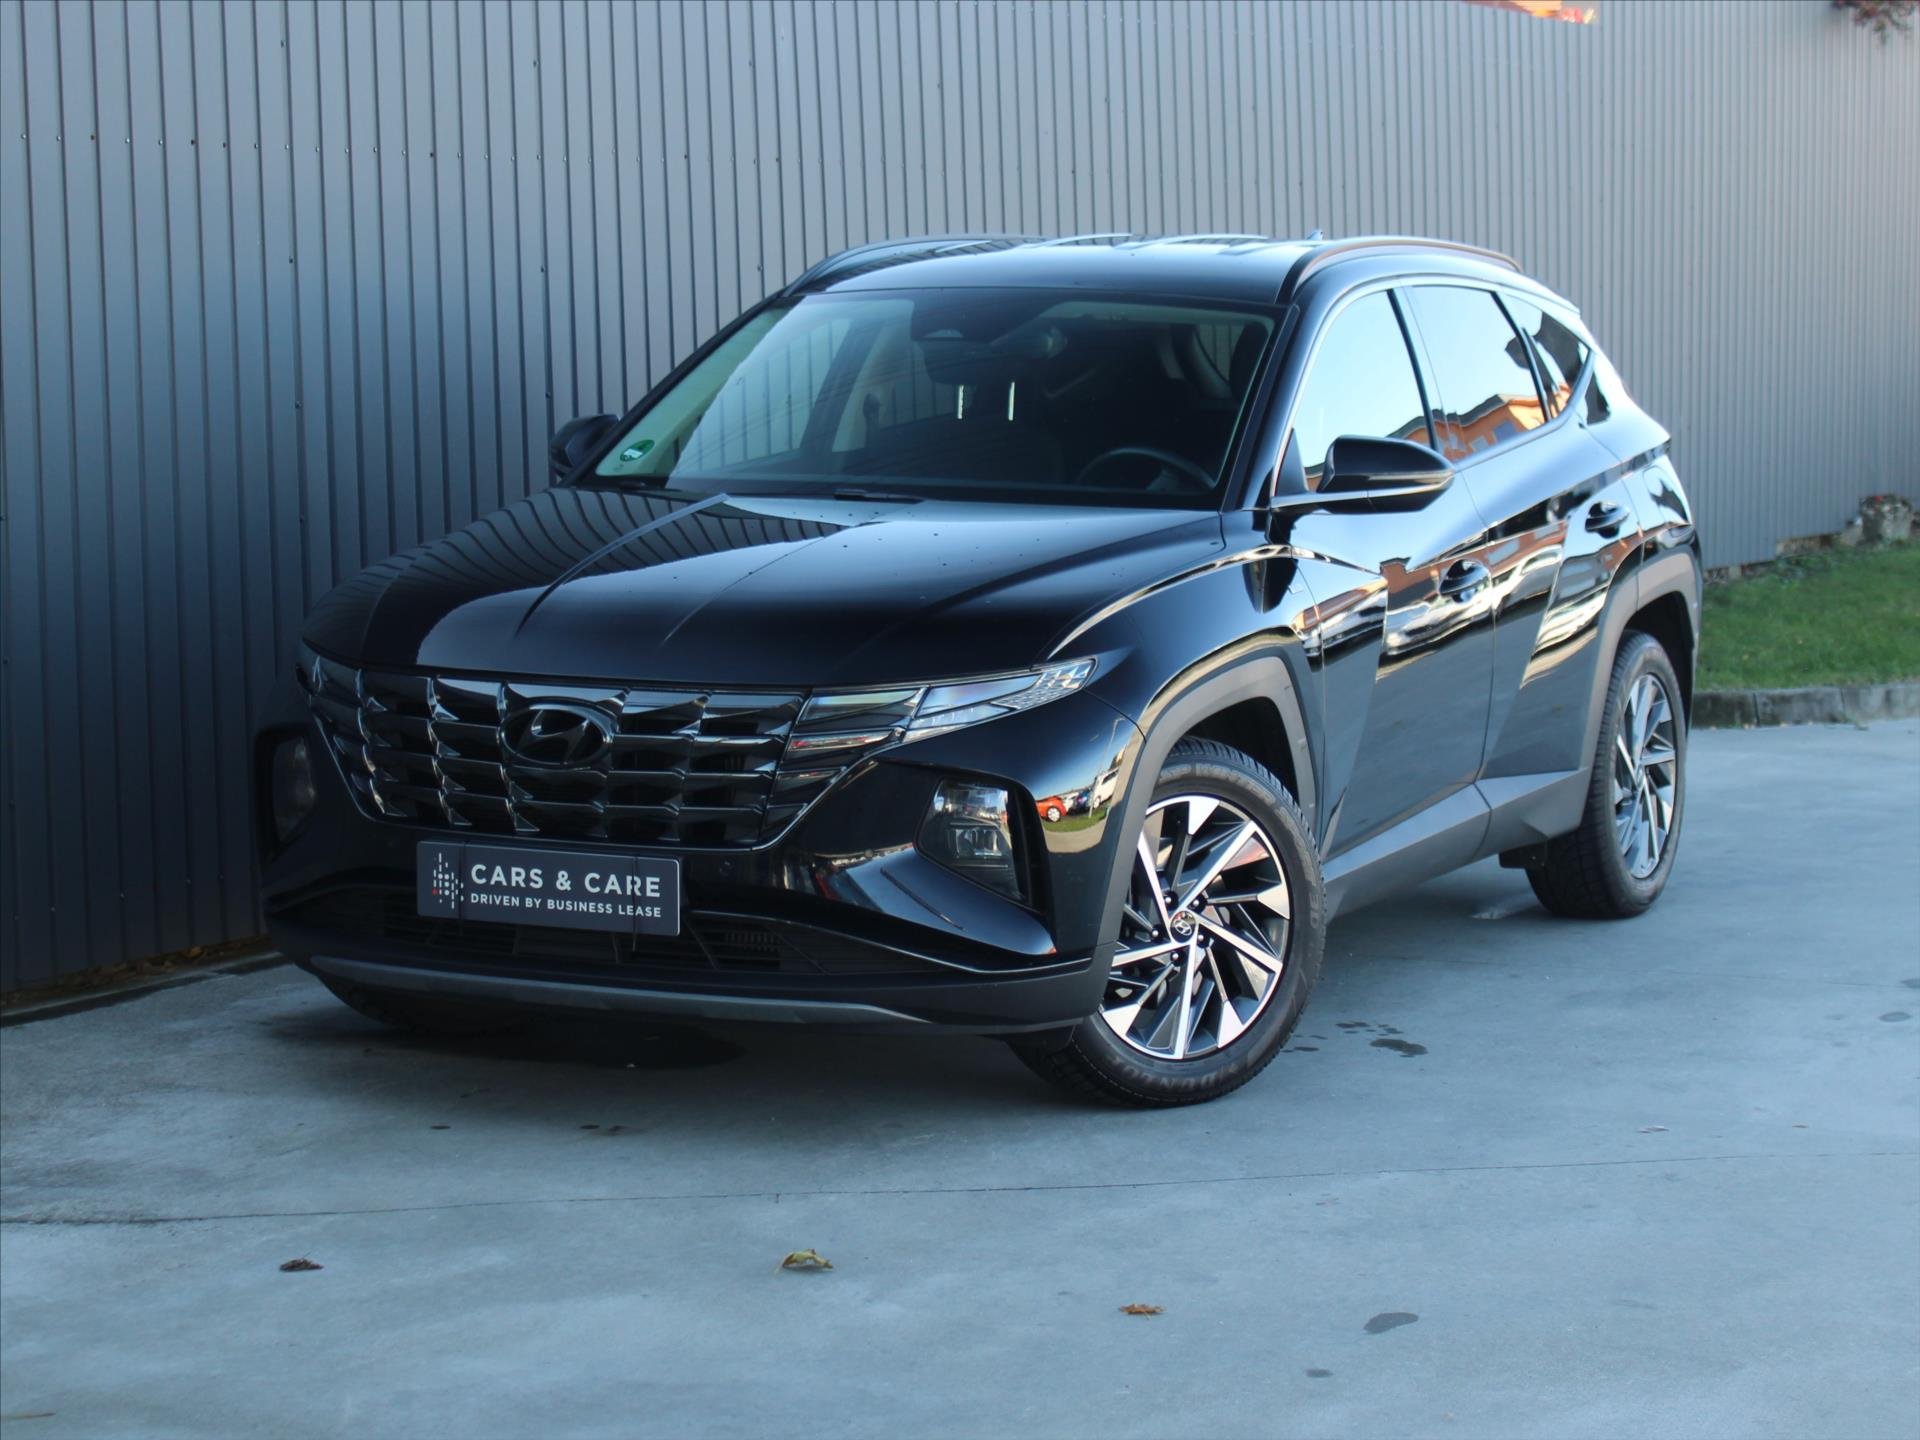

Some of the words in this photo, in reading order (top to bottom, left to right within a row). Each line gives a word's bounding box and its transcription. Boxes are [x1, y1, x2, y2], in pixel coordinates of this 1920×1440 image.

[471, 864, 543, 889] CARS
[556, 870, 571, 891] &
[584, 873, 661, 898] CARE
[471, 892, 520, 907] DRIVEN
[525, 897, 542, 909] BY
[547, 899, 613, 914] BUSINESS
[618, 904, 661, 918] LEASE
